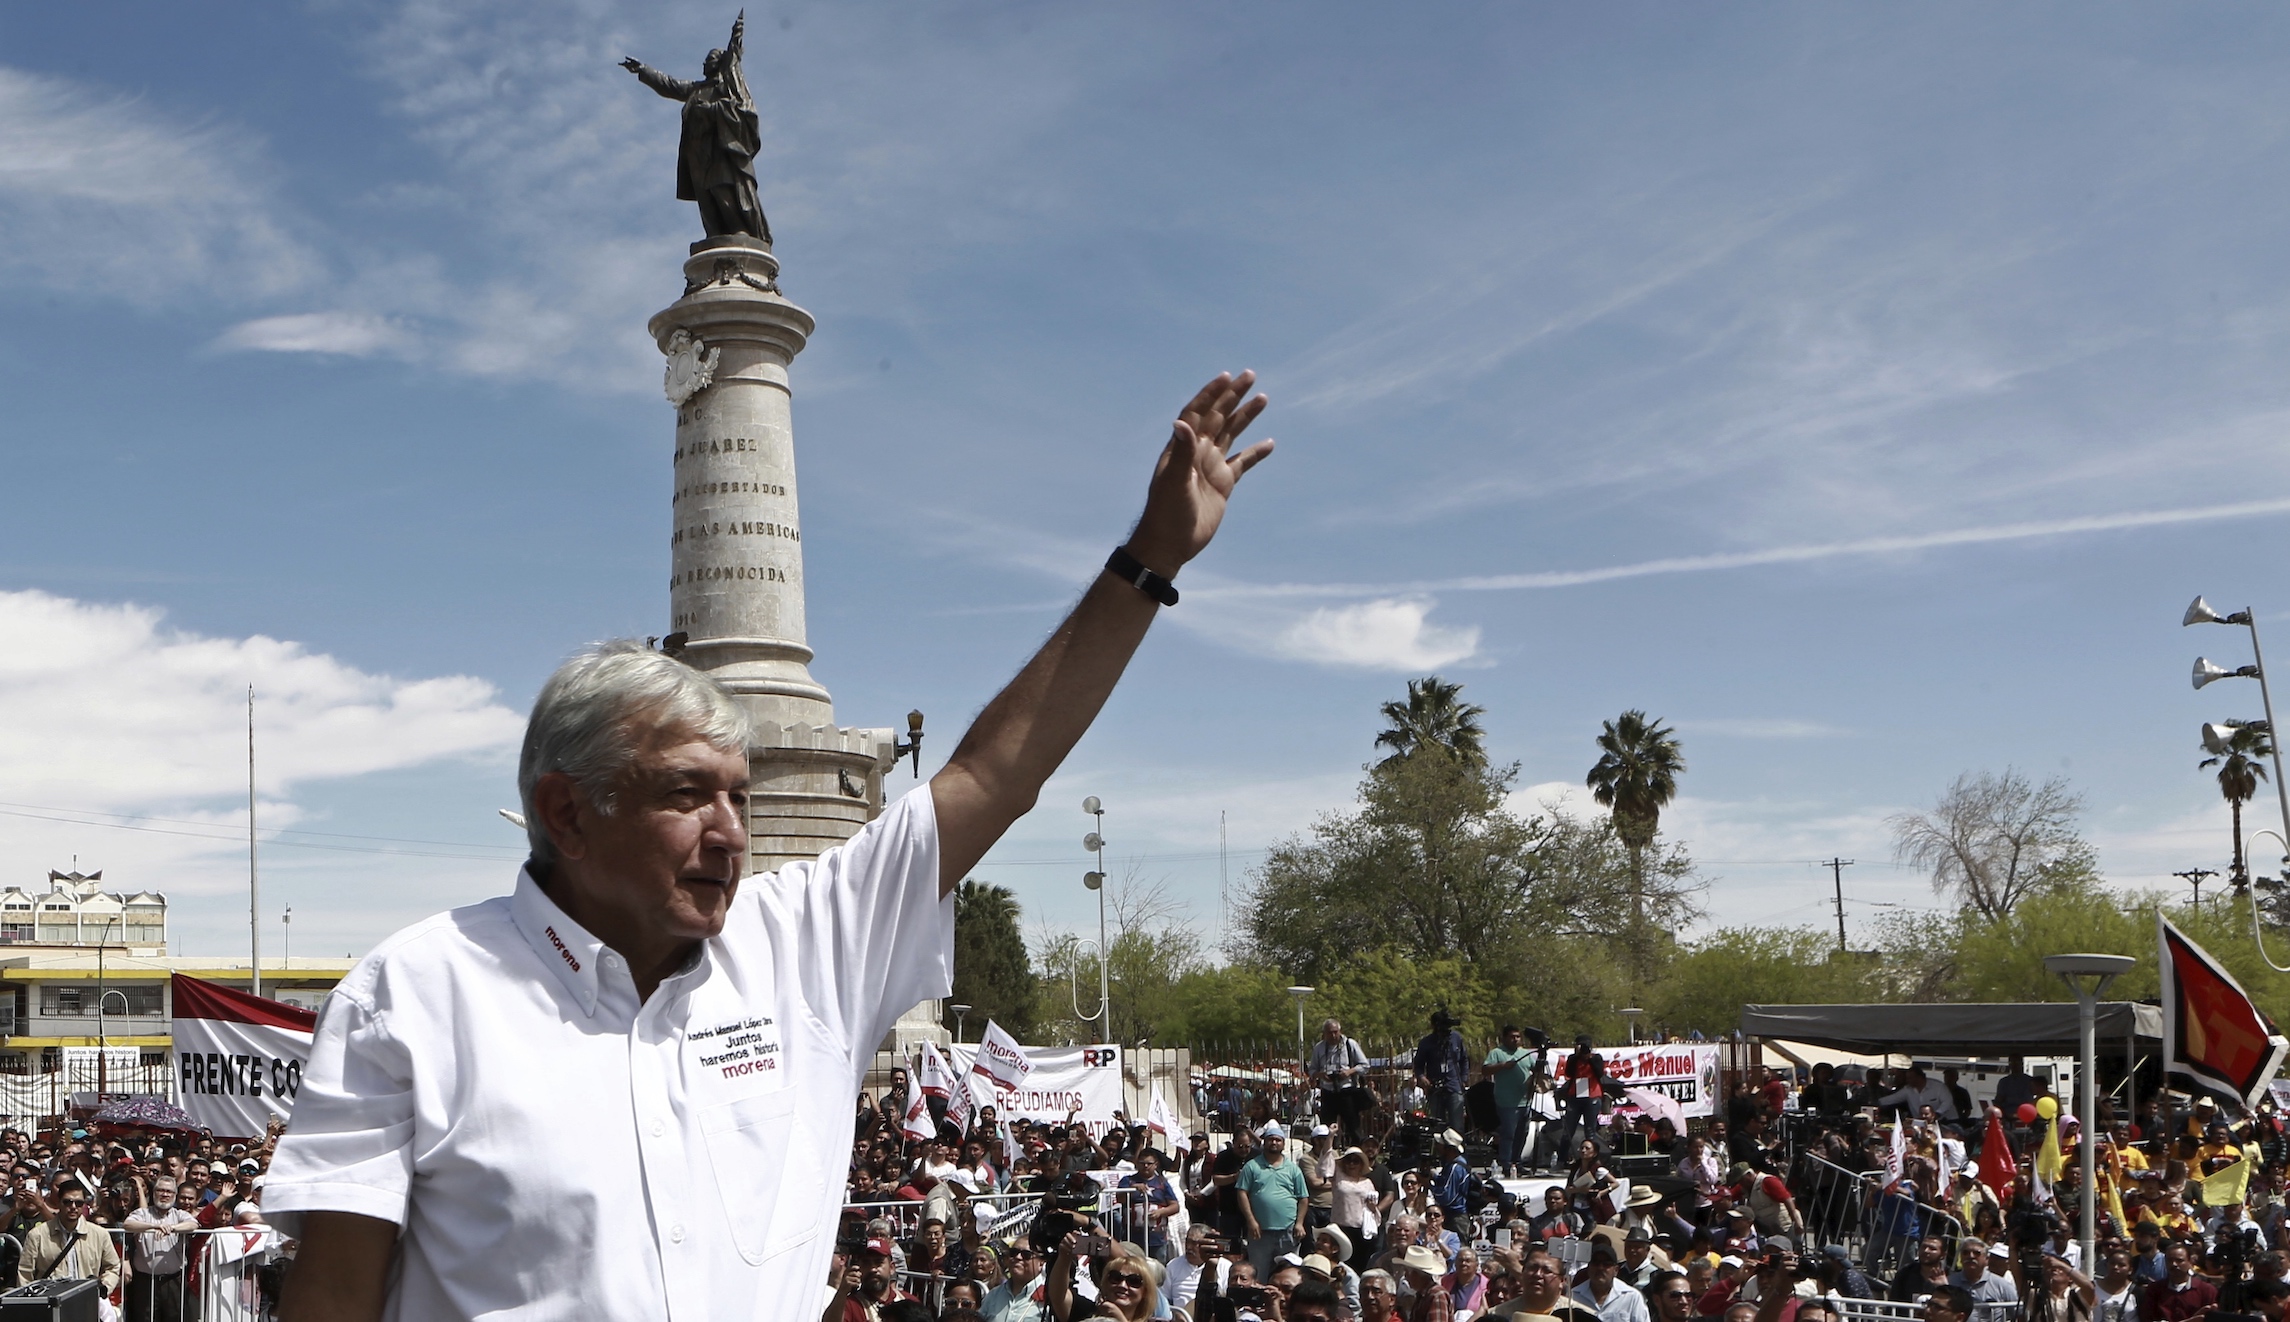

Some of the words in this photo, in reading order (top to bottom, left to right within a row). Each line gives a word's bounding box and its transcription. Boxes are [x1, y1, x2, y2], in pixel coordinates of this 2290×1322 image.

[689, 438, 758, 457] JUAREZ
[694, 482, 786, 497] LIBERTADOR
[690, 522, 720, 539] LAS
[687, 566, 786, 584] RECONOCIDA
[545, 926, 581, 973] morena
[687, 1028, 714, 1042] Andrés
[715, 1021, 742, 1036] Manuel
[725, 1033, 763, 1048] Juntos
[699, 1049, 750, 1067] haremos
[986, 1039, 1029, 1073] morena
[1638, 1050, 1696, 1079] Manuel
[181, 1052, 262, 1097] FRENTE
[271, 1058, 306, 1099] CO
[721, 1058, 776, 1079] morena
[996, 1091, 1083, 1112] REPUDIAMOS
